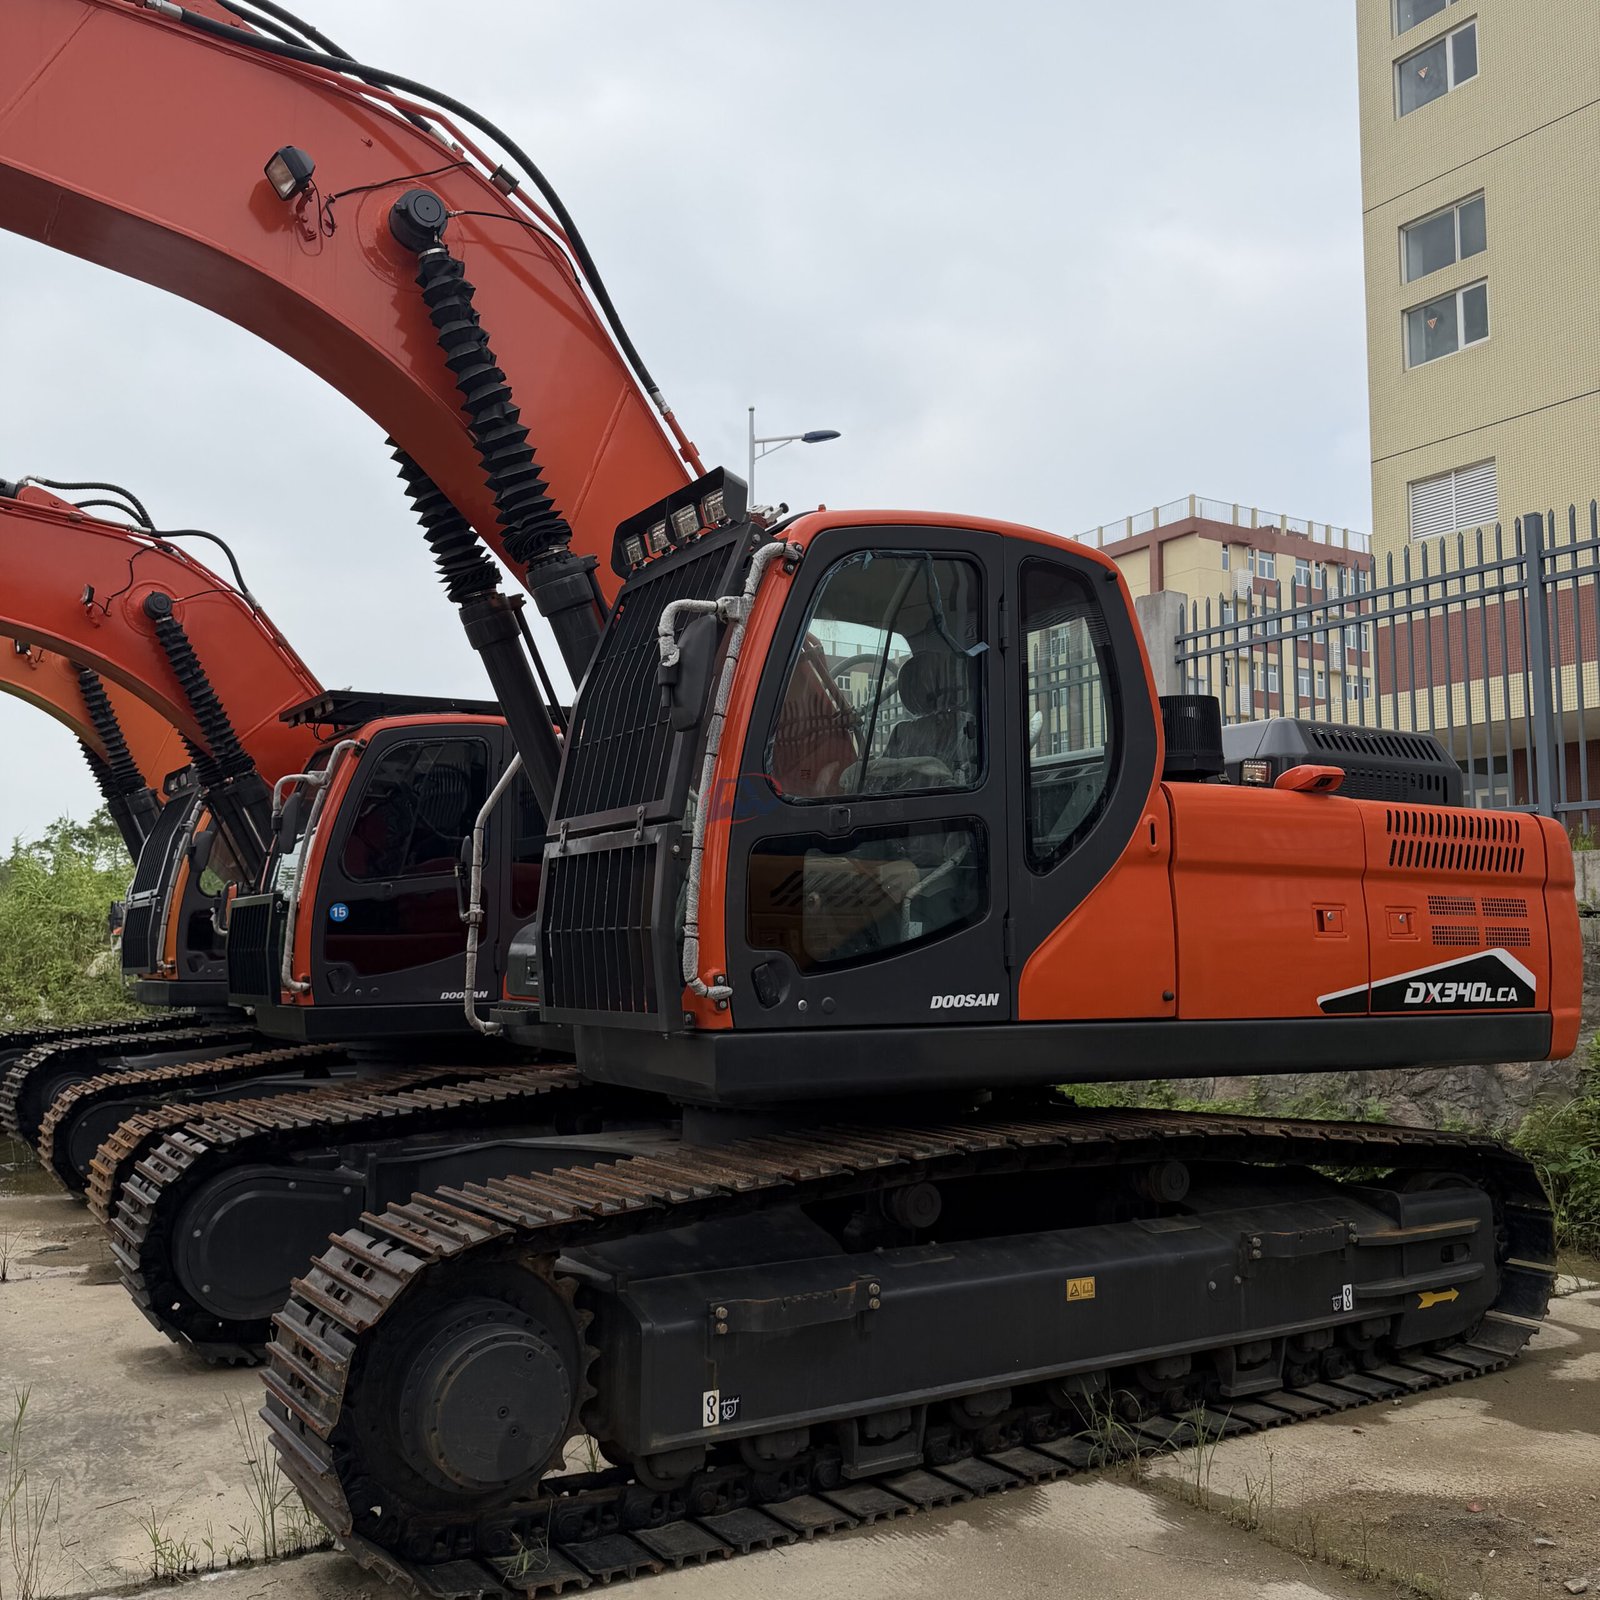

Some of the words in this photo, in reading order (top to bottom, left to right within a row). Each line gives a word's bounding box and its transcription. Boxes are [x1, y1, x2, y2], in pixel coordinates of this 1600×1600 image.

[332, 907, 346, 917] 15
[440, 991, 488, 999] DOOAN
[1404, 982, 1518, 1003] DX340LCA
[930, 993, 1000, 1009] DOOSAN
